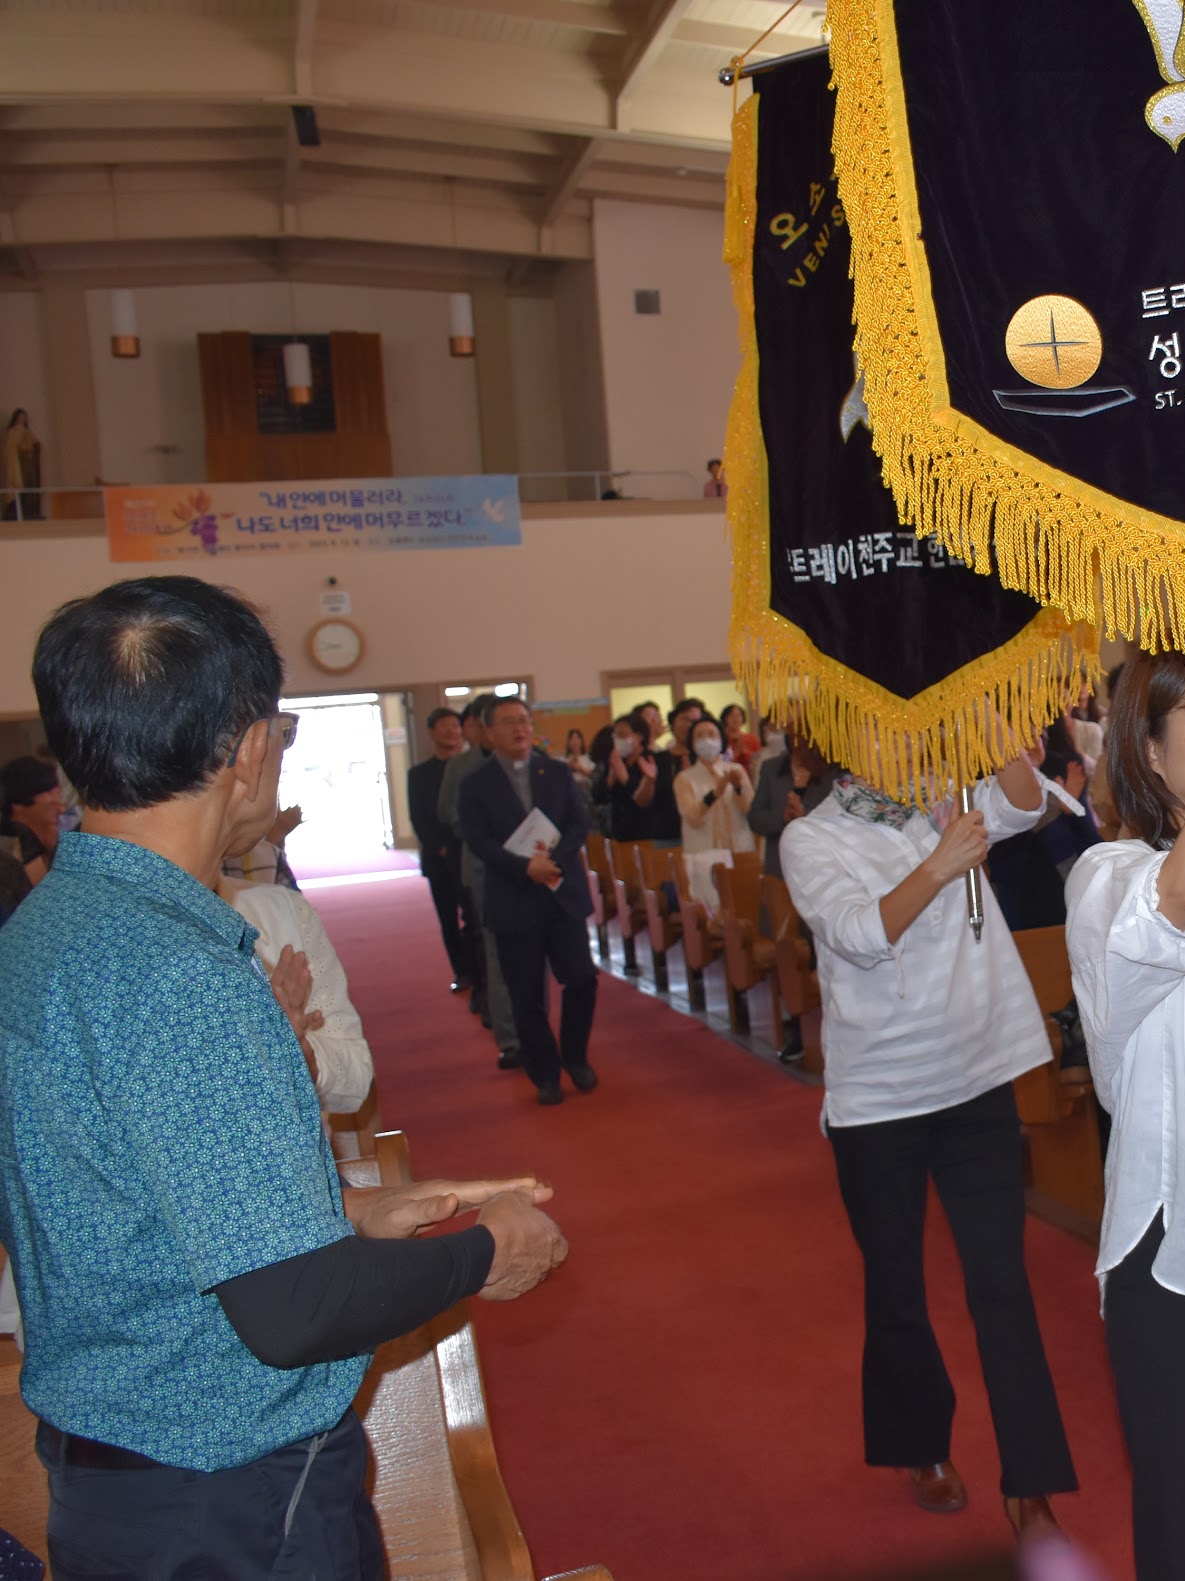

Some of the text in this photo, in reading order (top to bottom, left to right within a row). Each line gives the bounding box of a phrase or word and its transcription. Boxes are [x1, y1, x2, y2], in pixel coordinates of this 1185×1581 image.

[787, 222, 831, 288] VENI
[1148, 331, 1181, 379] 성
[1155, 389, 1182, 410] ST.
[236, 514, 277, 534] 나도
[279, 513, 320, 533] 너희
[322, 512, 363, 532] 안에
